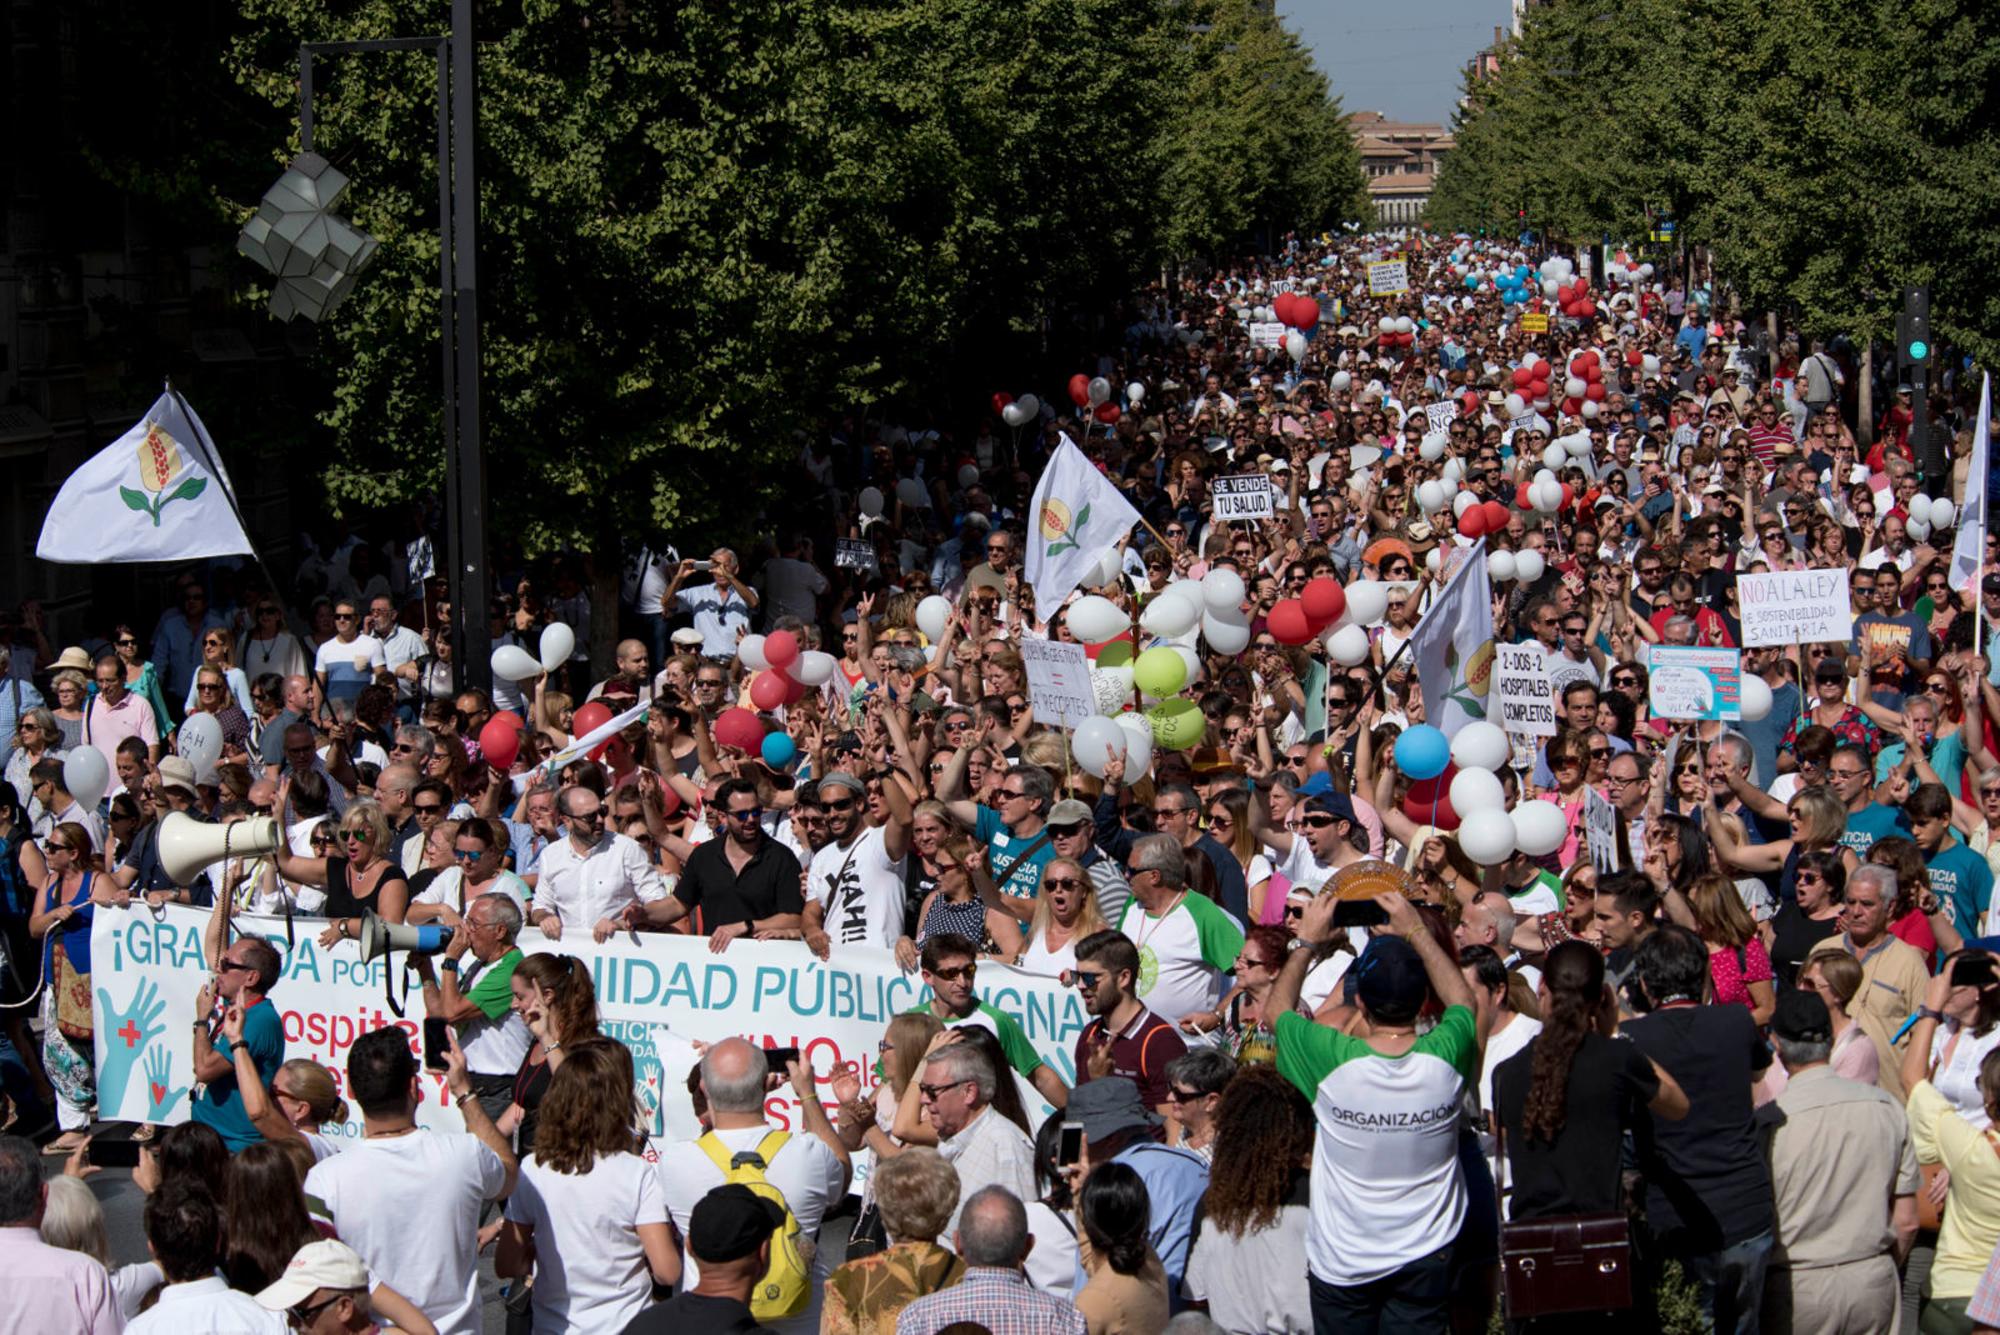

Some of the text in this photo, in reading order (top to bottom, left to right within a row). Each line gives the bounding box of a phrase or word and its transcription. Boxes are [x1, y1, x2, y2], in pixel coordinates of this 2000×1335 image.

[1214, 478, 1267, 493] SE VENDE
[1218, 496, 1231, 514] TU
[1741, 580, 1765, 603] NO
[1809, 575, 1839, 599] LEY
[1756, 605, 1837, 623] SOSTENIBILIDAD
[1751, 621, 1829, 641] SANITARIA
[1501, 677, 1550, 697] HOSPITALES
[1503, 702, 1553, 723] COMPLETOS
[1843, 831, 1874, 845] TICIA
[1927, 868, 1958, 884] TICIA
[1332, 1101, 1456, 1126] ORGANIZACIÓN
